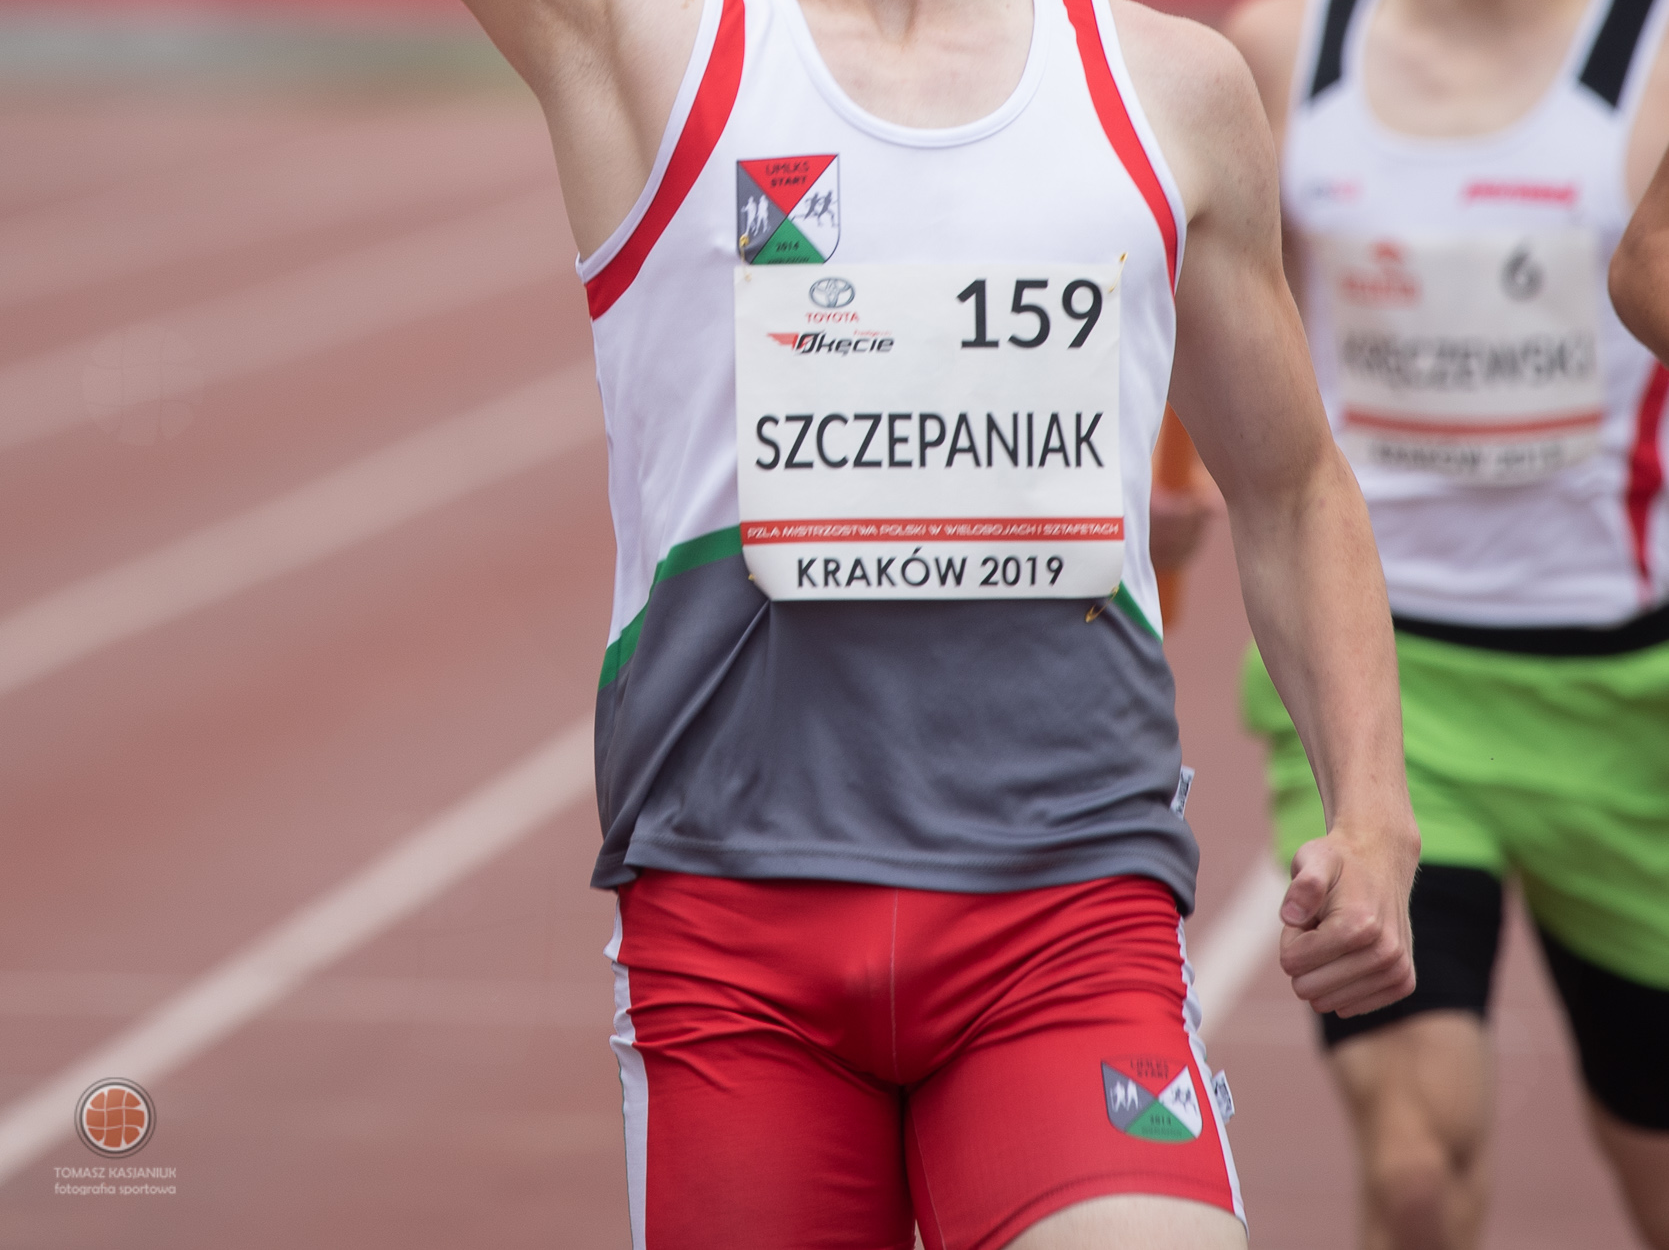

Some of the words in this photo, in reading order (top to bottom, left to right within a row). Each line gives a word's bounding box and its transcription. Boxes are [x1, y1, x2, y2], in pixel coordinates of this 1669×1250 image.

[805, 311, 860, 324] TOYOTA
[956, 279, 1103, 349] 159
[755, 412, 1104, 470] SZCZEPANIAK
[747, 527, 779, 539] PZLA
[782, 525, 877, 538] MISTRZOSTWA
[879, 524, 926, 536] POLSKI
[945, 523, 1036, 536] WIELOBOJACH
[1043, 523, 1119, 535] SZTAFETACH
[797, 546, 968, 588] KRAKÓW
[979, 556, 1064, 587] 2019
